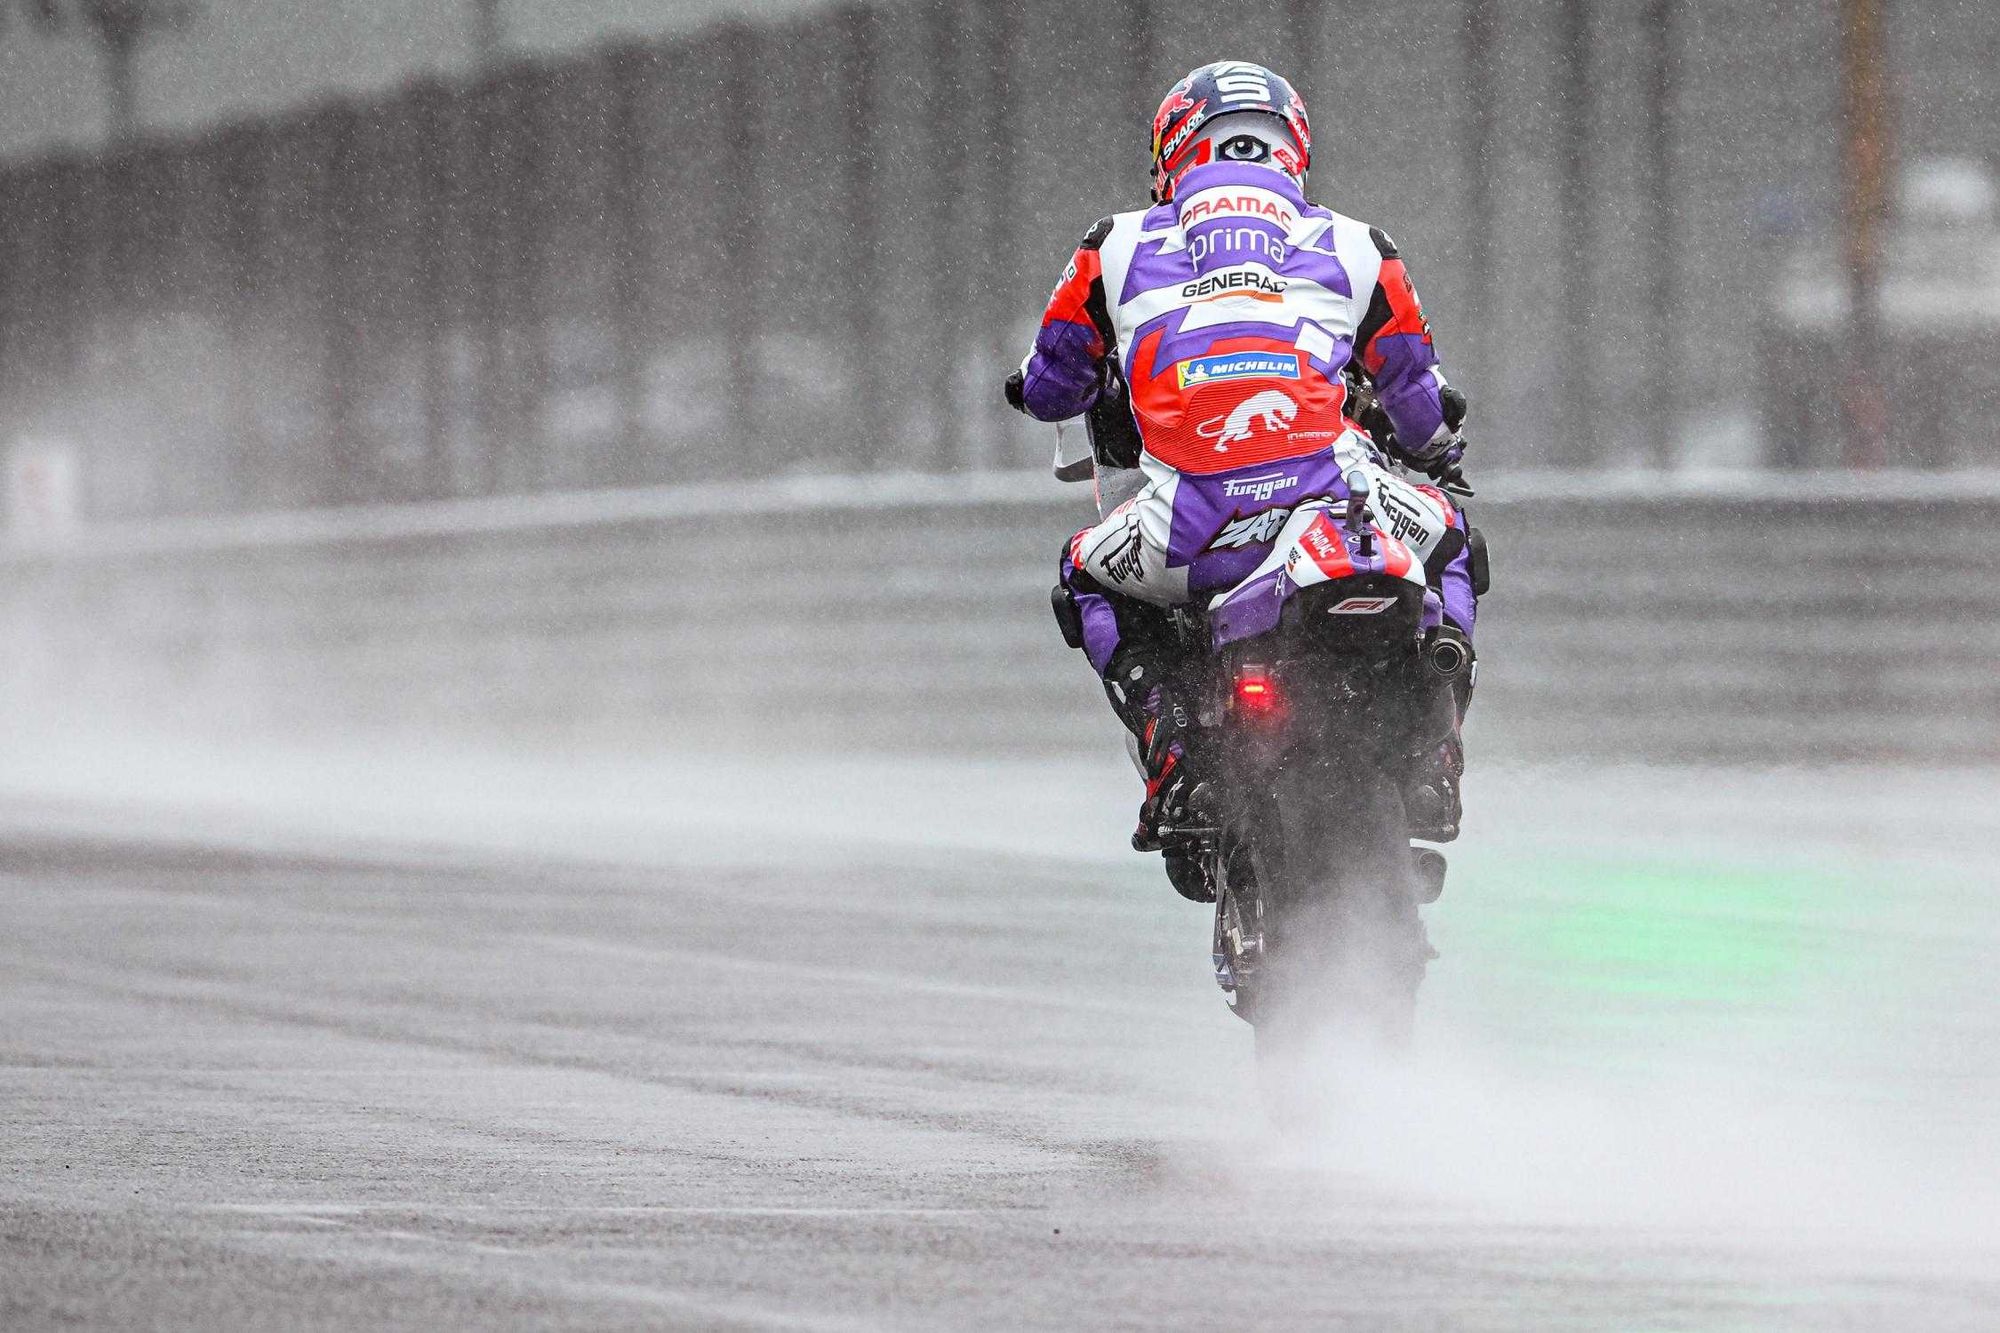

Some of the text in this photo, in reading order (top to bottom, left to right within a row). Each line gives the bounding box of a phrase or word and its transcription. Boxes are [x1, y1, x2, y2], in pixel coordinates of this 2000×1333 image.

[1162, 107, 1206, 160] SHARK
[1181, 196, 1292, 231] PRAMAC
[1187, 228, 1285, 273] prima
[1182, 272, 1288, 298] GENERAC
[1211, 360, 1296, 374] MICHELIN
